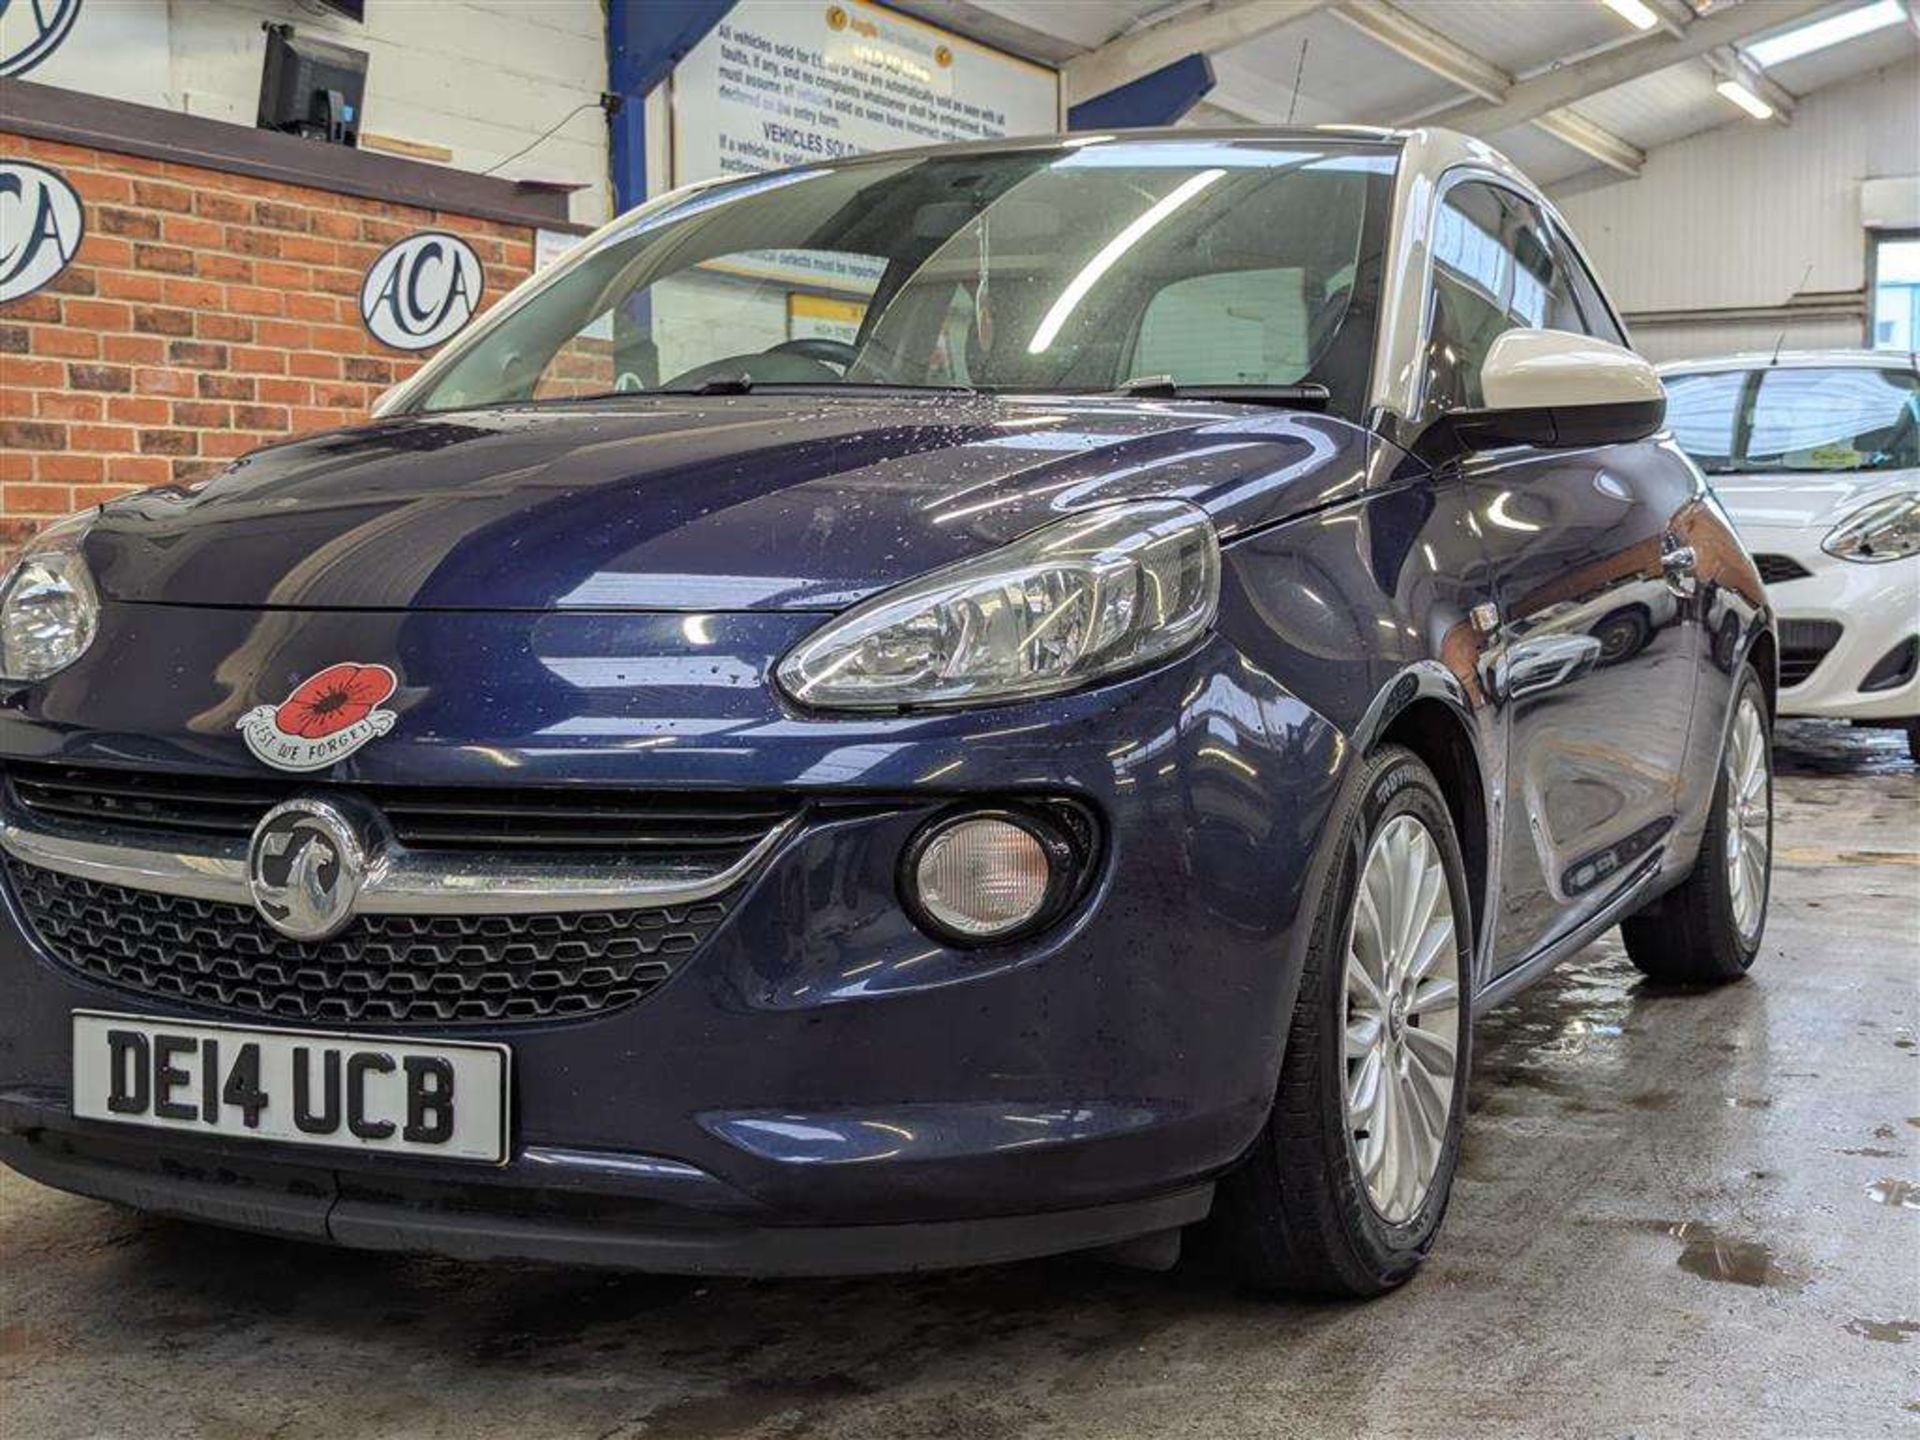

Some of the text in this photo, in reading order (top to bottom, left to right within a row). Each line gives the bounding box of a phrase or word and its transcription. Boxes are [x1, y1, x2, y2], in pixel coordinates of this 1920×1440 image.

[720, 24, 731, 40] All
[733, 31, 772, 53] vehicles
[775, 44, 794, 60] sold
[797, 47, 809, 63] for
[885, 79, 934, 106] automatically
[937, 95, 951, 110] sold
[783, 65, 800, 80] and
[815, 76, 860, 99] complaints
[745, 74, 781, 91] assume
[835, 98, 852, 114] sold
[738, 142, 770, 160] vehicle
[763, 122, 856, 158] VEHICLES SOLD
[367, 240, 472, 336] ACA
[278, 743, 298, 761] WE
[308, 724, 368, 760] FORGET
[108, 1030, 454, 1145] DE14 UCB
